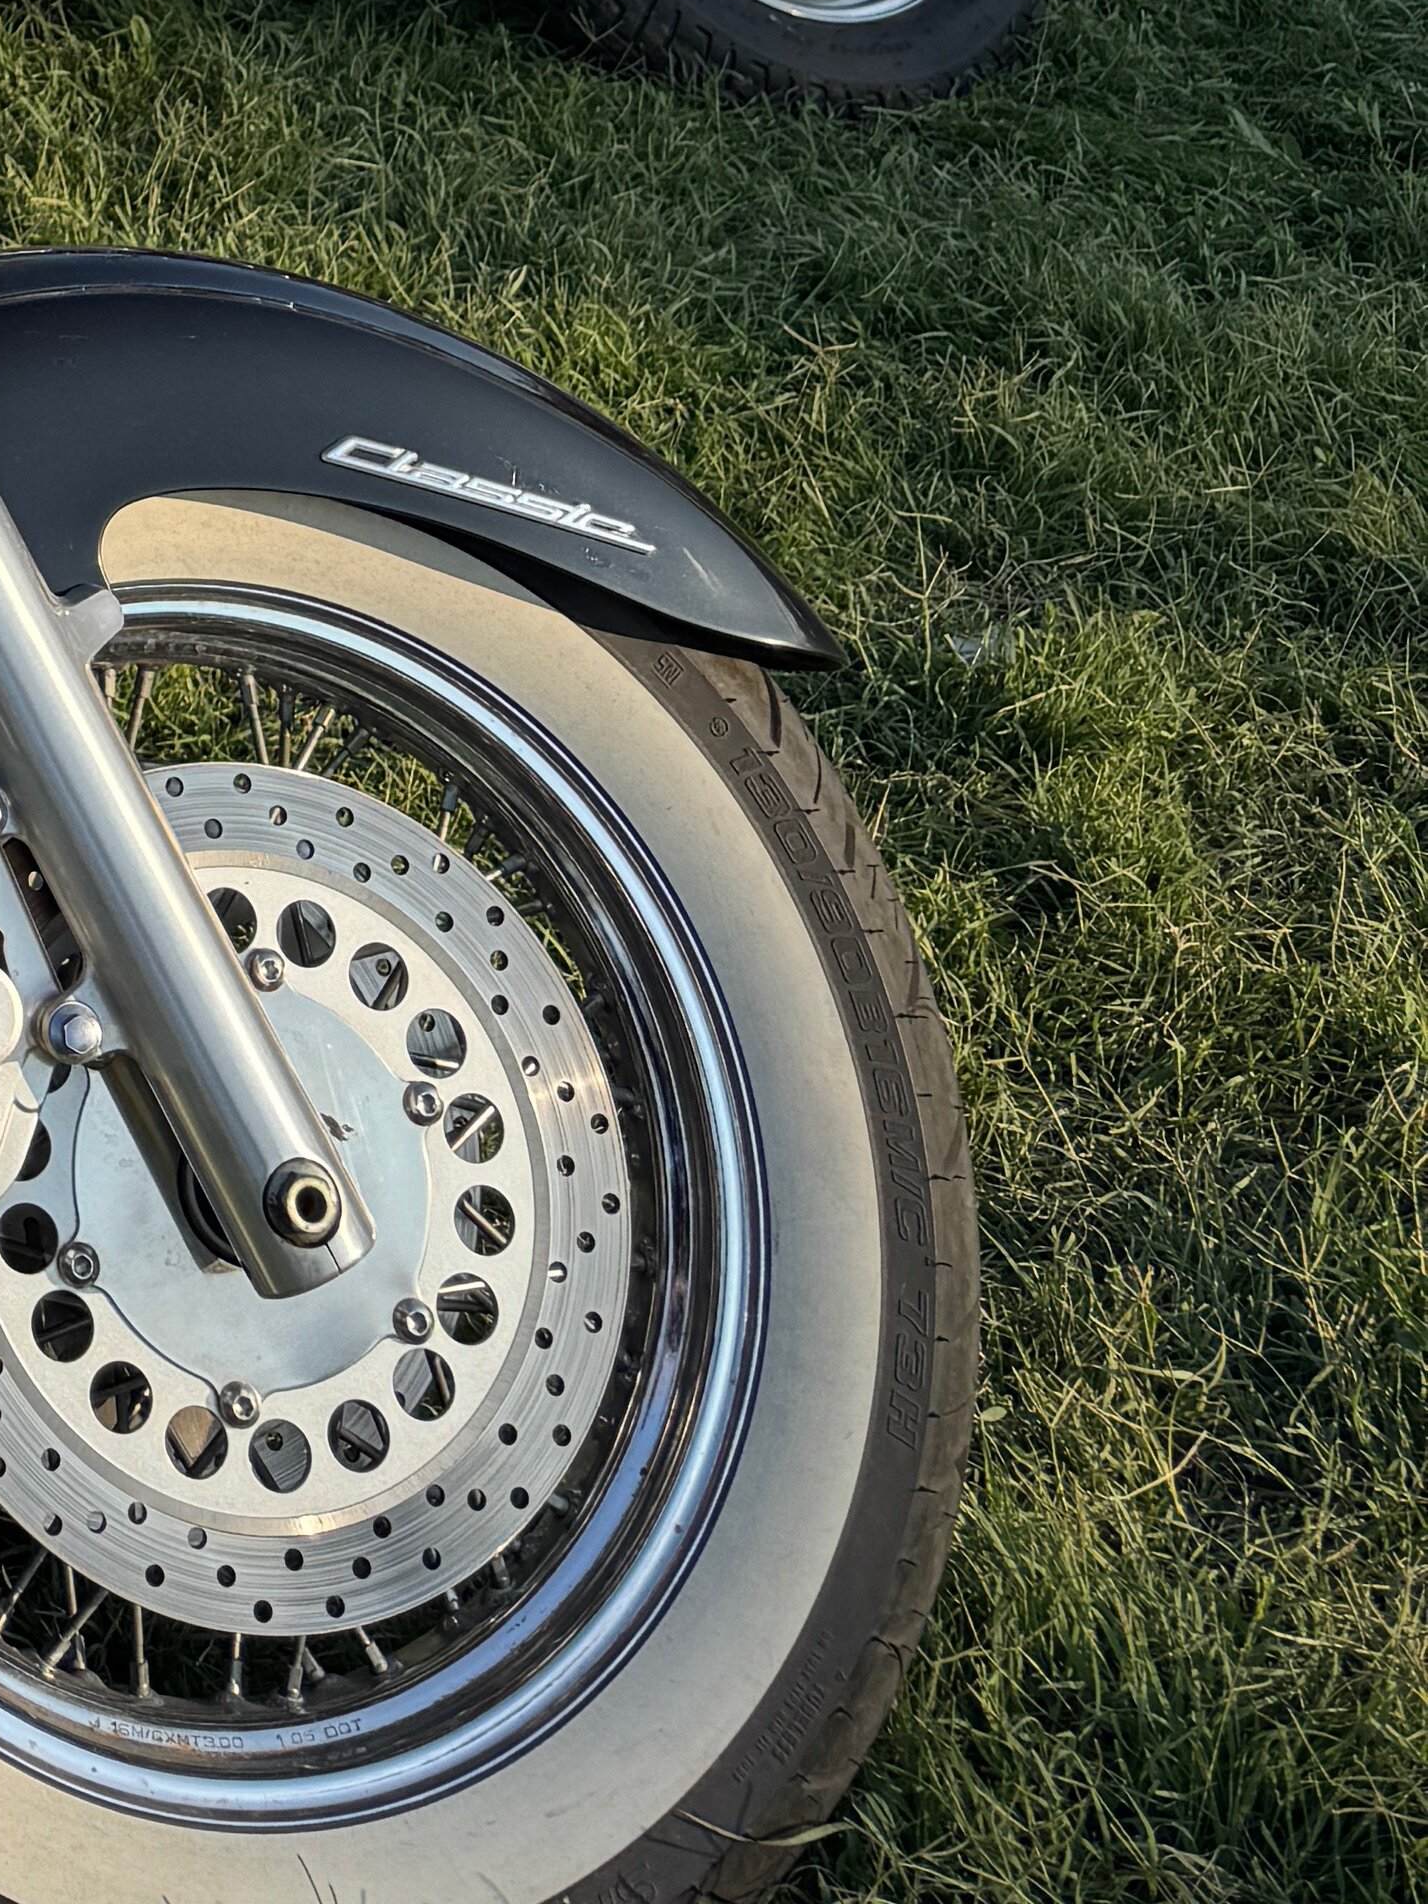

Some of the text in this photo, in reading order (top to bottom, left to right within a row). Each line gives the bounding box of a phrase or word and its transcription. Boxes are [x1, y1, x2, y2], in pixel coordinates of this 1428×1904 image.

[321, 436, 657, 554] Classic
[887, 1290, 930, 1450] 73H
[324, 1718, 362, 1739] DOT
